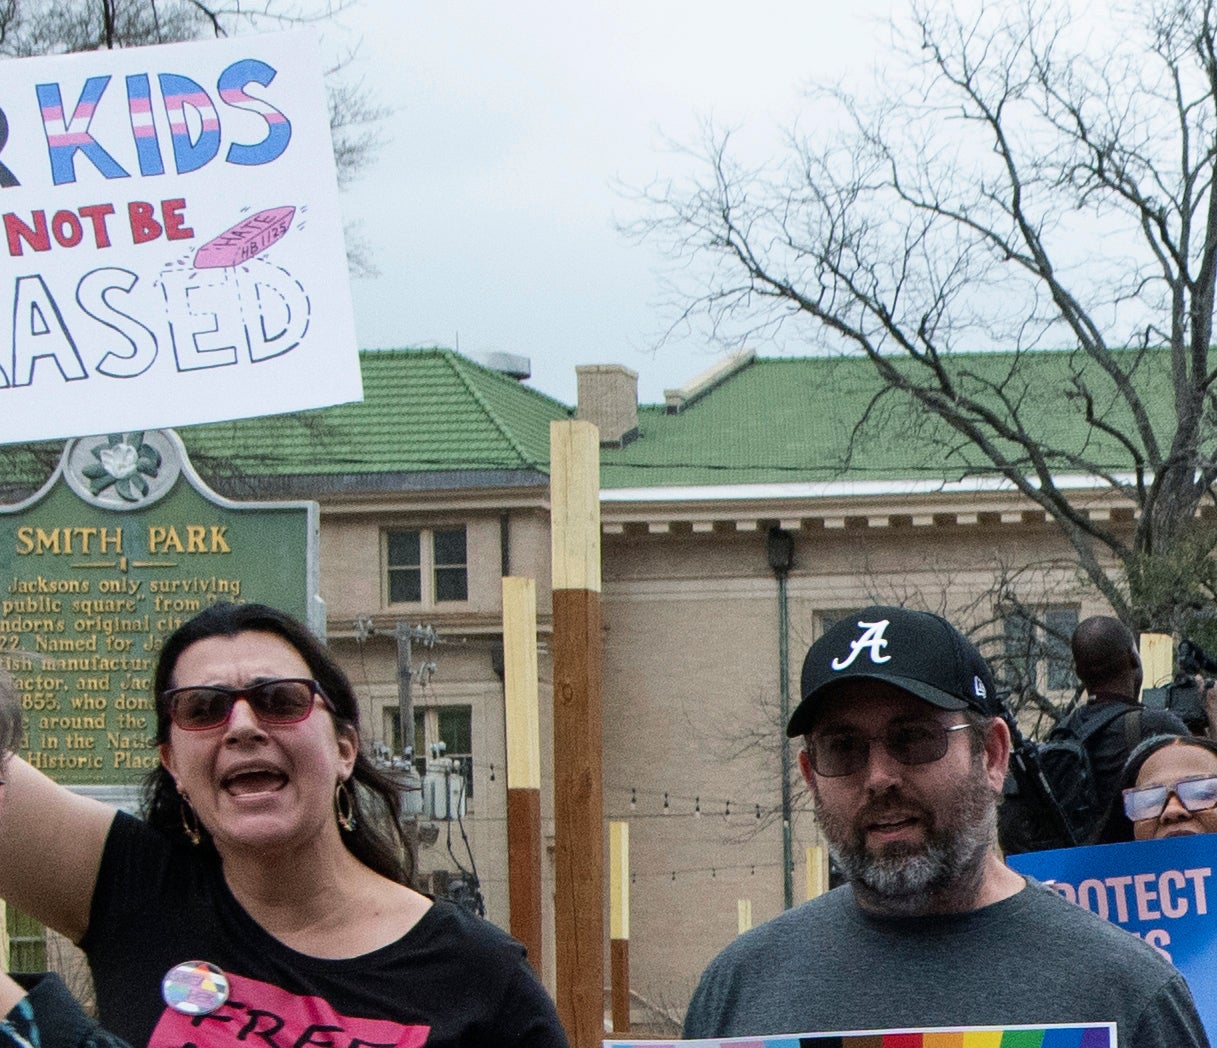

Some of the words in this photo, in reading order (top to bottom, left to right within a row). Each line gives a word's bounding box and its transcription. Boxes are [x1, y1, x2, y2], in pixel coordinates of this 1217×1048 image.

[35, 58, 292, 186] KIDS
[2, 203, 116, 257] NOT
[127, 198, 195, 244] BE
[15, 525, 124, 555] SMITH
[147, 524, 232, 554] PARK
[98, 576, 142, 596] only
[149, 575, 241, 596] surviving
[154, 594, 200, 612] from
[74, 614, 150, 636] original
[156, 615, 183, 631] cit
[35, 632, 97, 651] Named
[105, 634, 132, 651] for
[42, 654, 158, 671] manufactur
[75, 674, 110, 690] and
[20, 691, 61, 711] 855,
[70, 692, 107, 710] who
[39, 712, 105, 730] around
[118, 712, 147, 729] the
[40, 732, 59, 749] in
[65, 731, 95, 749] the
[27, 751, 103, 769] Historic
[113, 750, 160, 769] Place
